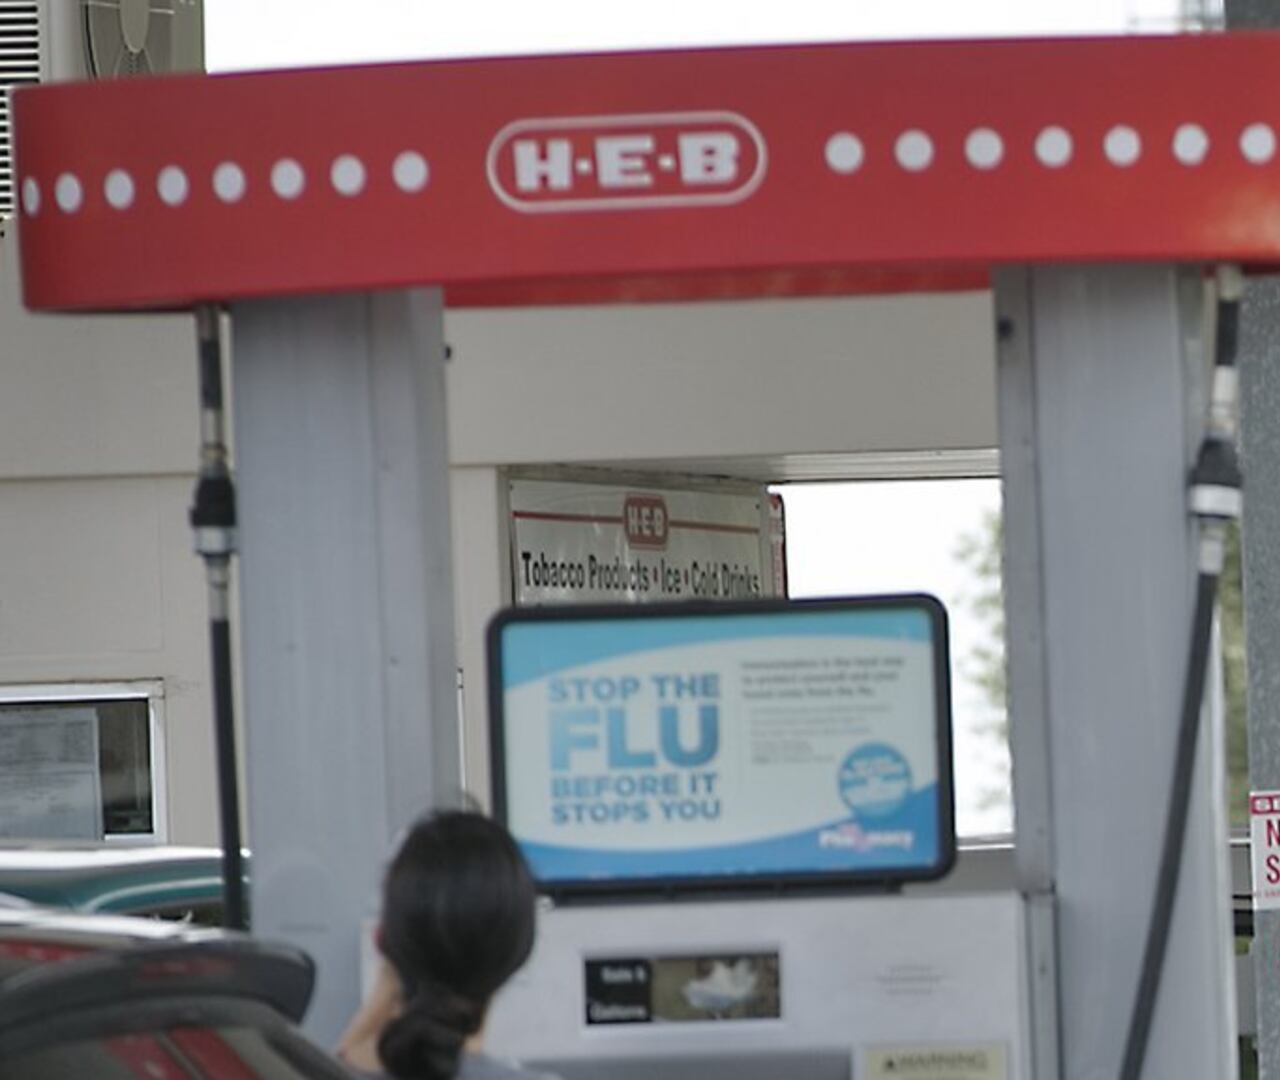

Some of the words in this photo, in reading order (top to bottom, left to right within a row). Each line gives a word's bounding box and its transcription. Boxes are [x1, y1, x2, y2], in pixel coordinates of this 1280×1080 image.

[521, 551, 584, 588] Tobacco
[589, 554, 650, 592] Products
[661, 558, 682, 593] Ice
[691, 561, 719, 595] Cold
[722, 563, 760, 597] Drinks
[548, 674, 641, 701] STOP
[651, 672, 720, 700] THE
[550, 704, 720, 770] FLU
[551, 772, 679, 799] BEFORE
[688, 771, 719, 795] IT
[551, 799, 652, 826] STOPS
[653, 797, 721, 820] YOU
